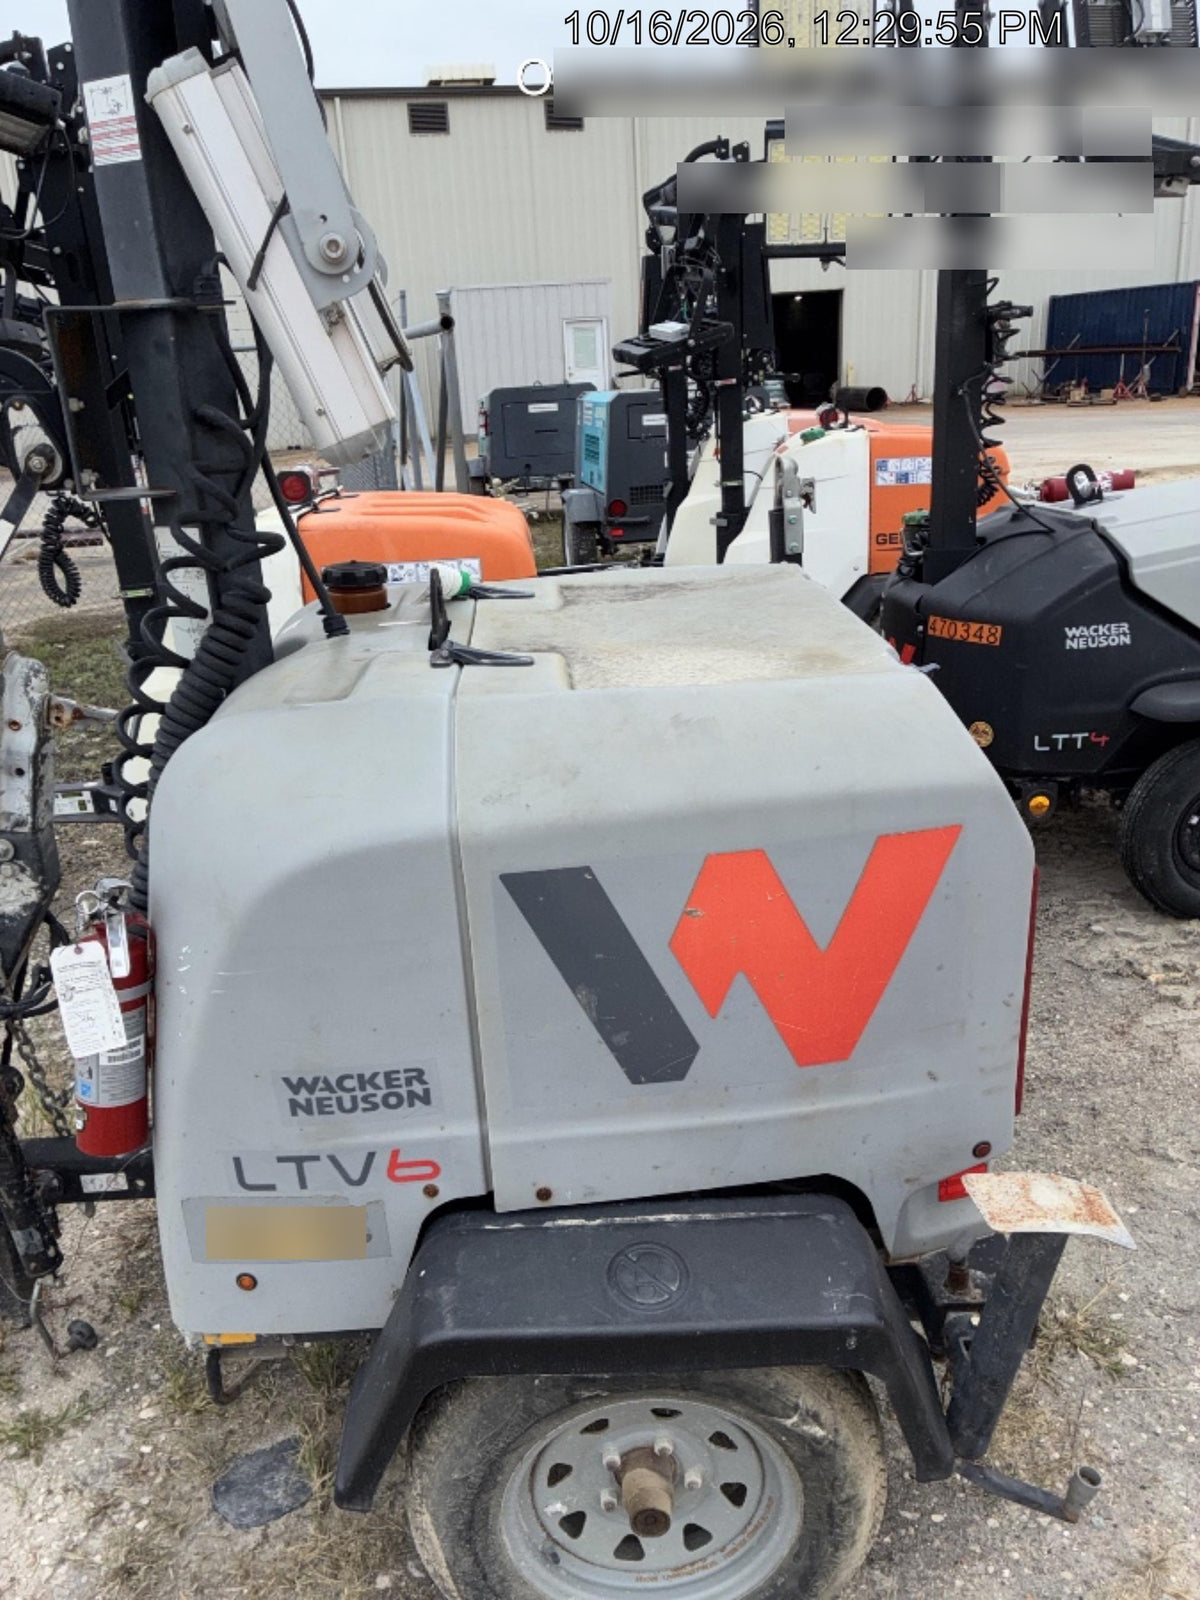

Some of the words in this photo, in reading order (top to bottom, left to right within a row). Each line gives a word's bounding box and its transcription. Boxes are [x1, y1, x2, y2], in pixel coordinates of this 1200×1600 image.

[876, 532, 904, 545] GE
[929, 618, 999, 644] 470348
[1064, 622, 1131, 638] WACKER
[1065, 634, 1132, 650] NEUSON
[1034, 732, 1110, 752] LTT4
[281, 1067, 430, 1096] WACKER
[288, 1087, 432, 1117] NEUSON
[232, 1148, 441, 1192] LTV6
